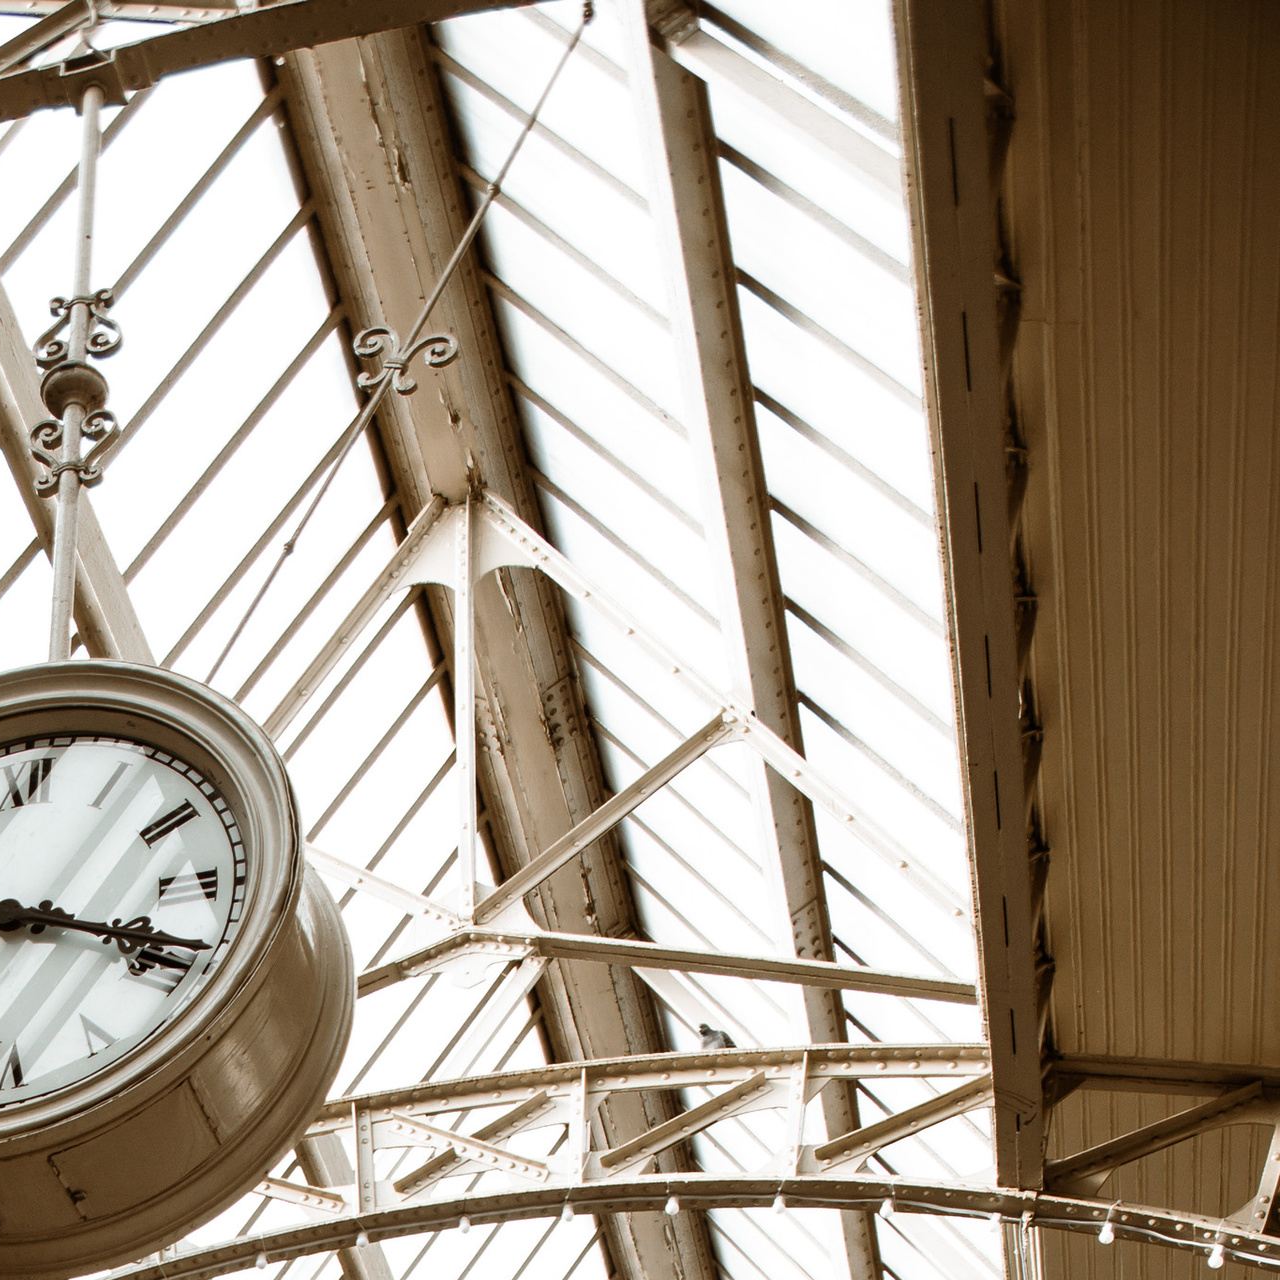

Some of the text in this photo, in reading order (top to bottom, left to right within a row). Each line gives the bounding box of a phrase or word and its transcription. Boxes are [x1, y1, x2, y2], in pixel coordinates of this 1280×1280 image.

[88, 760, 133, 810] I
[137, 799, 202, 848] II
[158, 866, 218, 908] III
[78, 1013, 120, 1058] V
